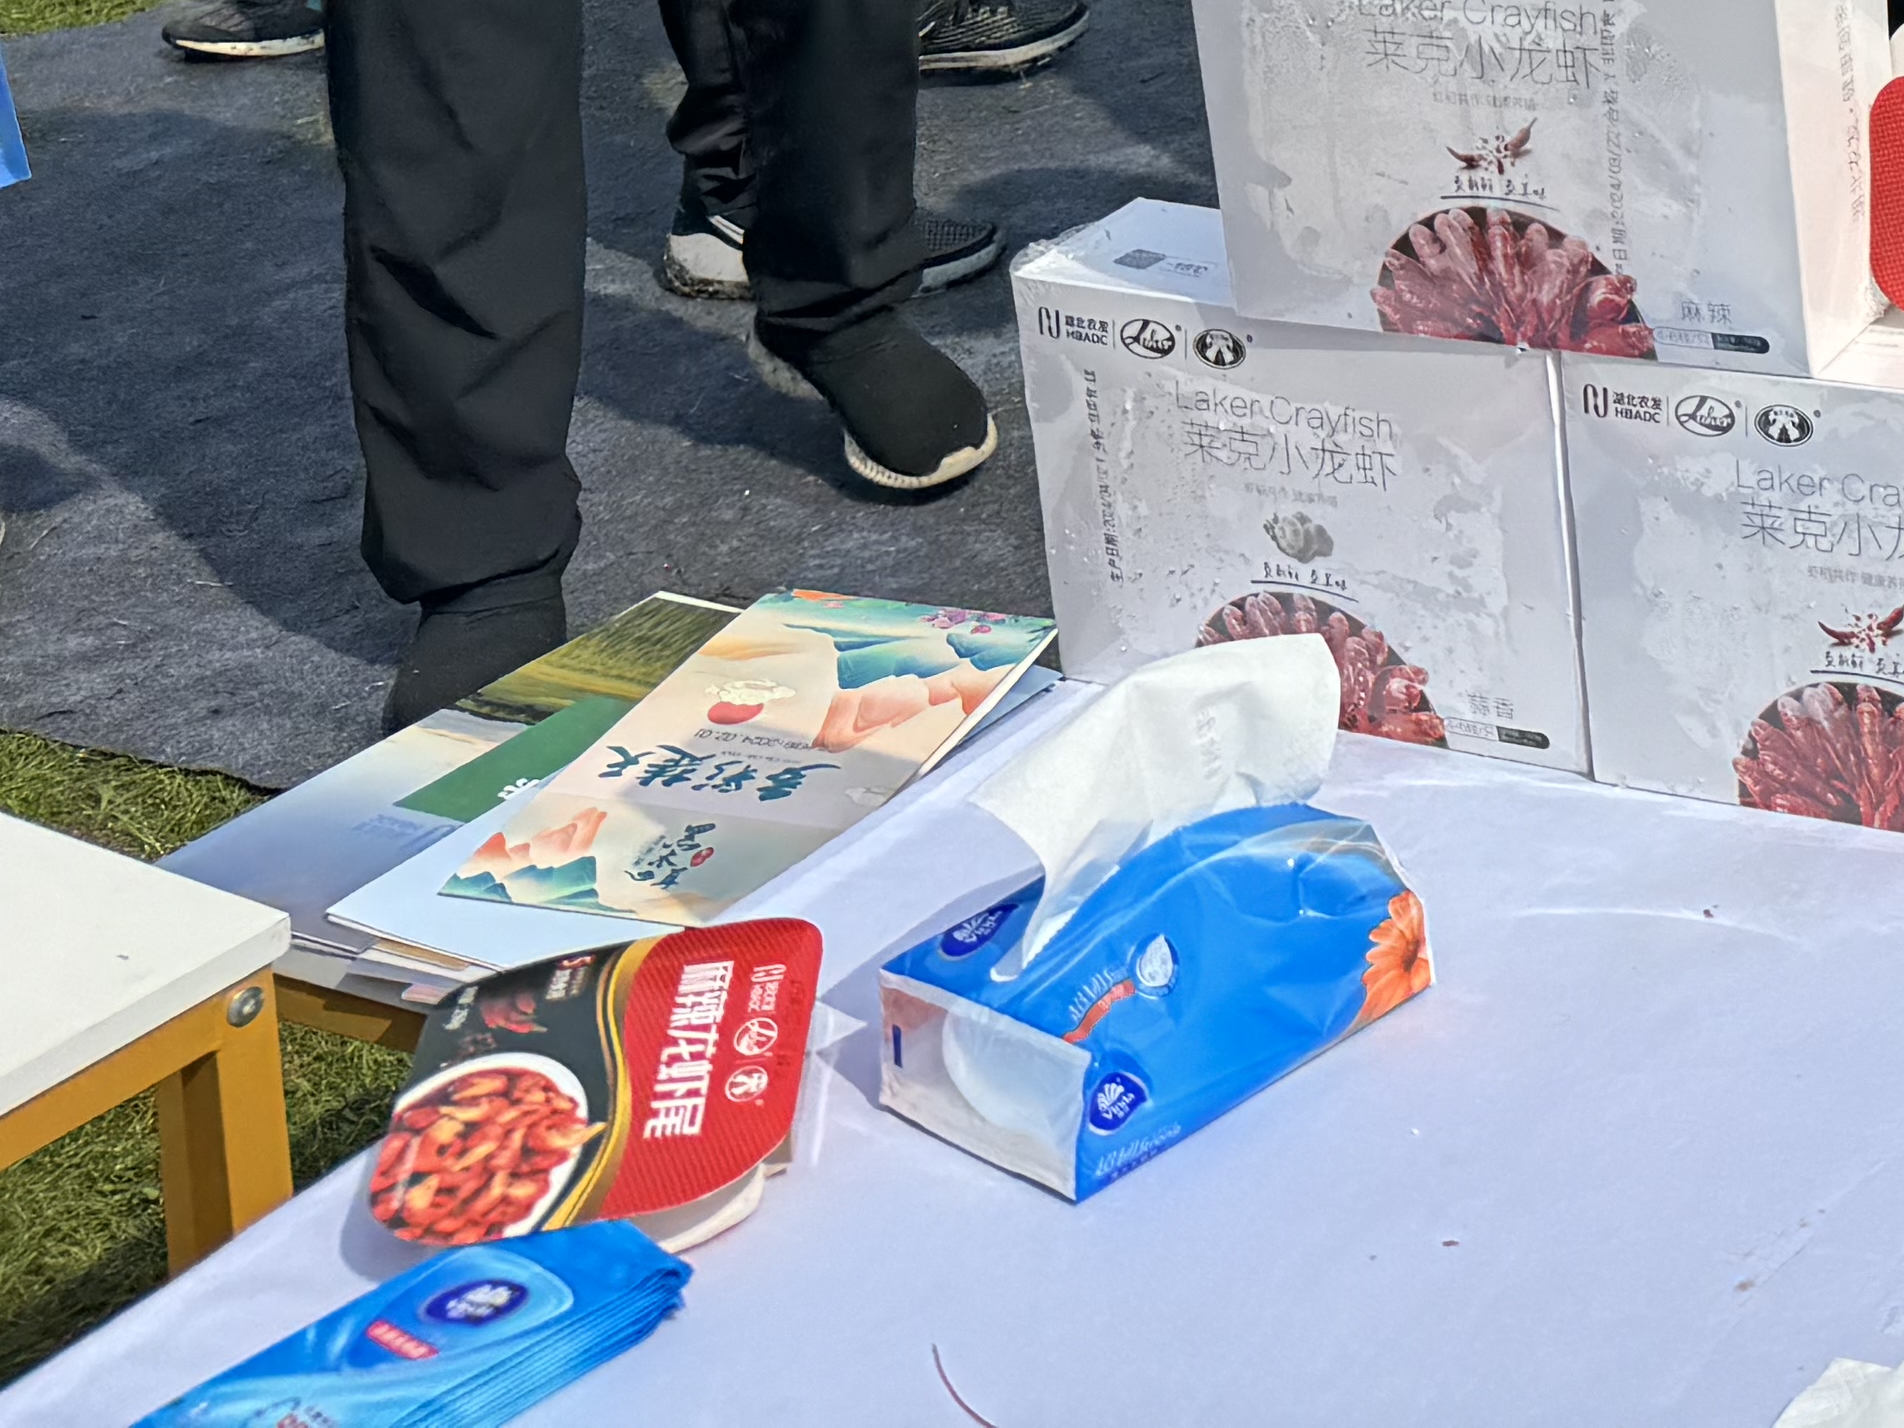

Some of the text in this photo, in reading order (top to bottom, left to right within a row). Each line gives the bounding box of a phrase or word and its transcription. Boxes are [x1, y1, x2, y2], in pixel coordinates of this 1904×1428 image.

[1361, 25, 1601, 89] 莱克小龙虾
[1174, 380, 1395, 438] Laker Crayfish
[1612, 390, 1663, 411] 湖北农发
[1614, 408, 1662, 424] HBADC
[1181, 417, 1398, 492] 莱克小龙虾
[1735, 459, 1833, 496] Laker
[643, 960, 735, 1139] 麻辣龙虾尾
